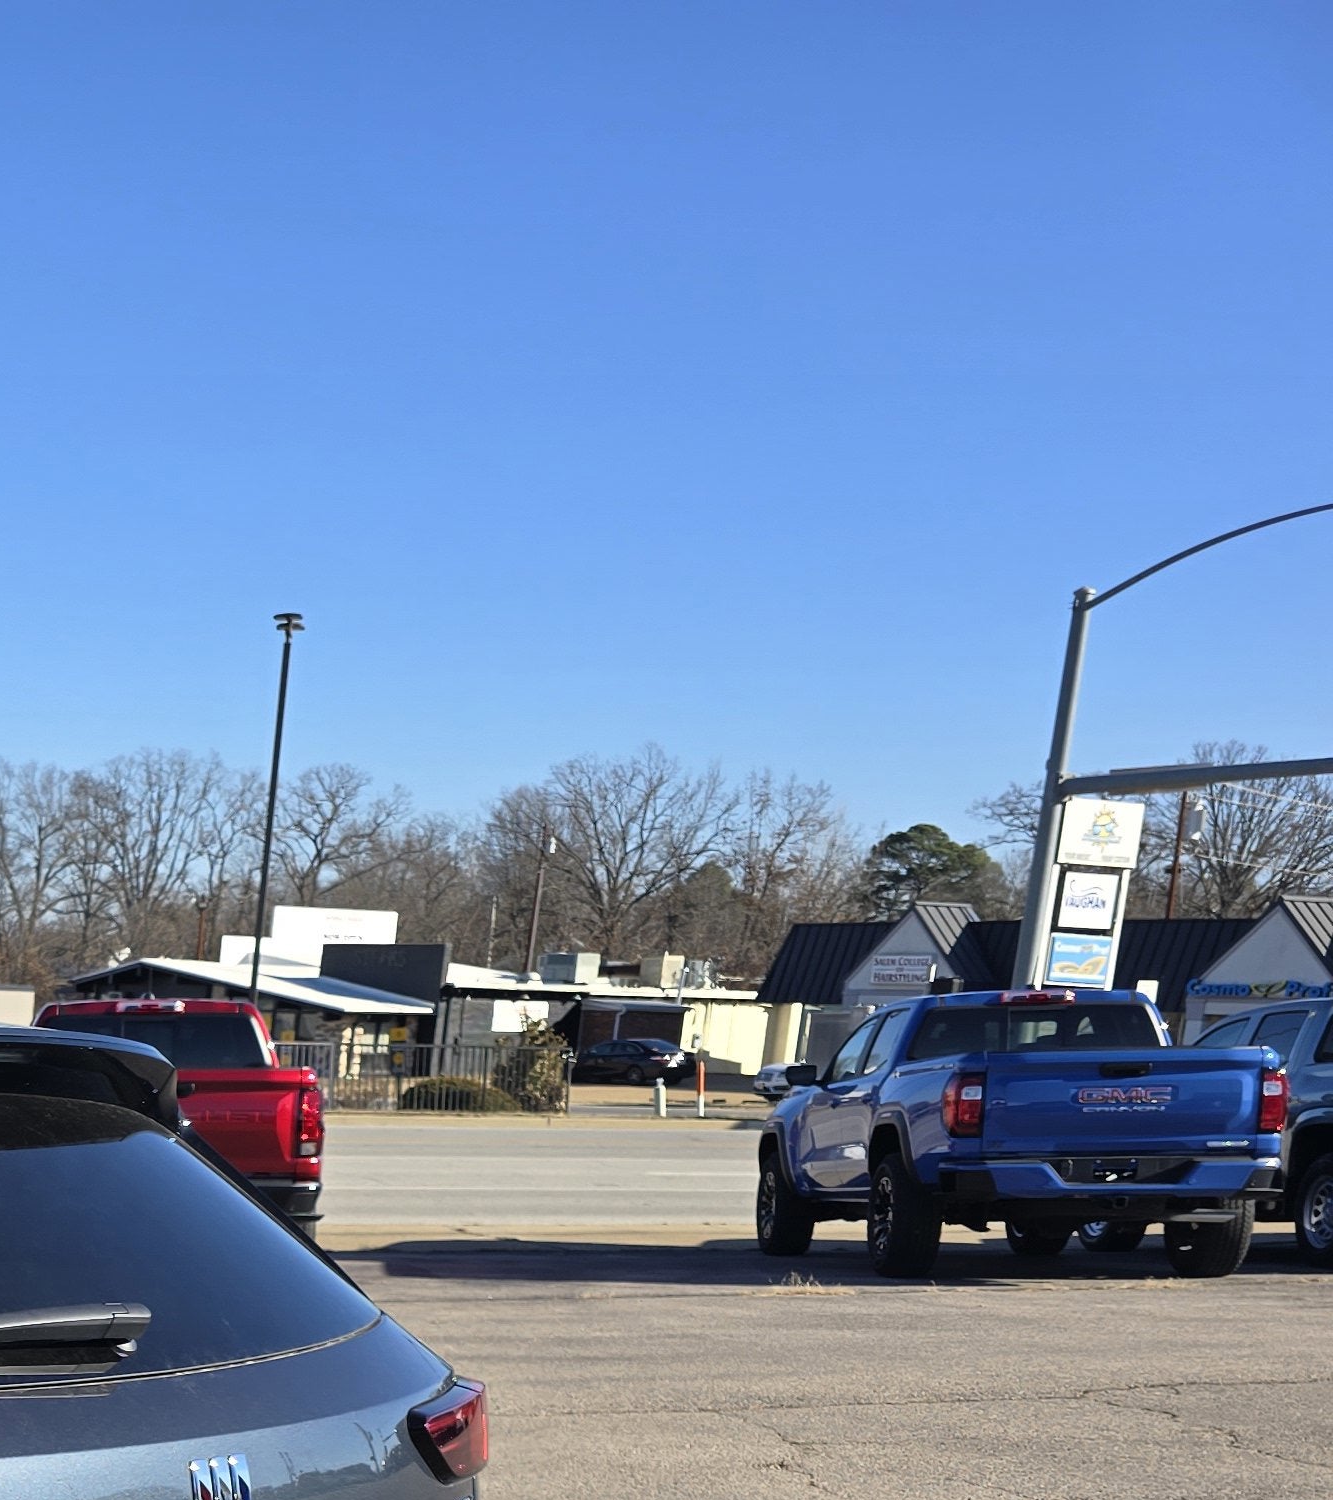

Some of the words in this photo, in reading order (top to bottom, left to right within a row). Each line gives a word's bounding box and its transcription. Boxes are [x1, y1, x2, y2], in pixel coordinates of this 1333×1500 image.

[1064, 895, 1106, 909] VAUGHAN
[874, 956, 897, 967] SALEM
[874, 972, 928, 982] HAIRSTYLING
[1186, 978, 1252, 997] Cosmo
[1078, 1086, 1172, 1104] GMC
